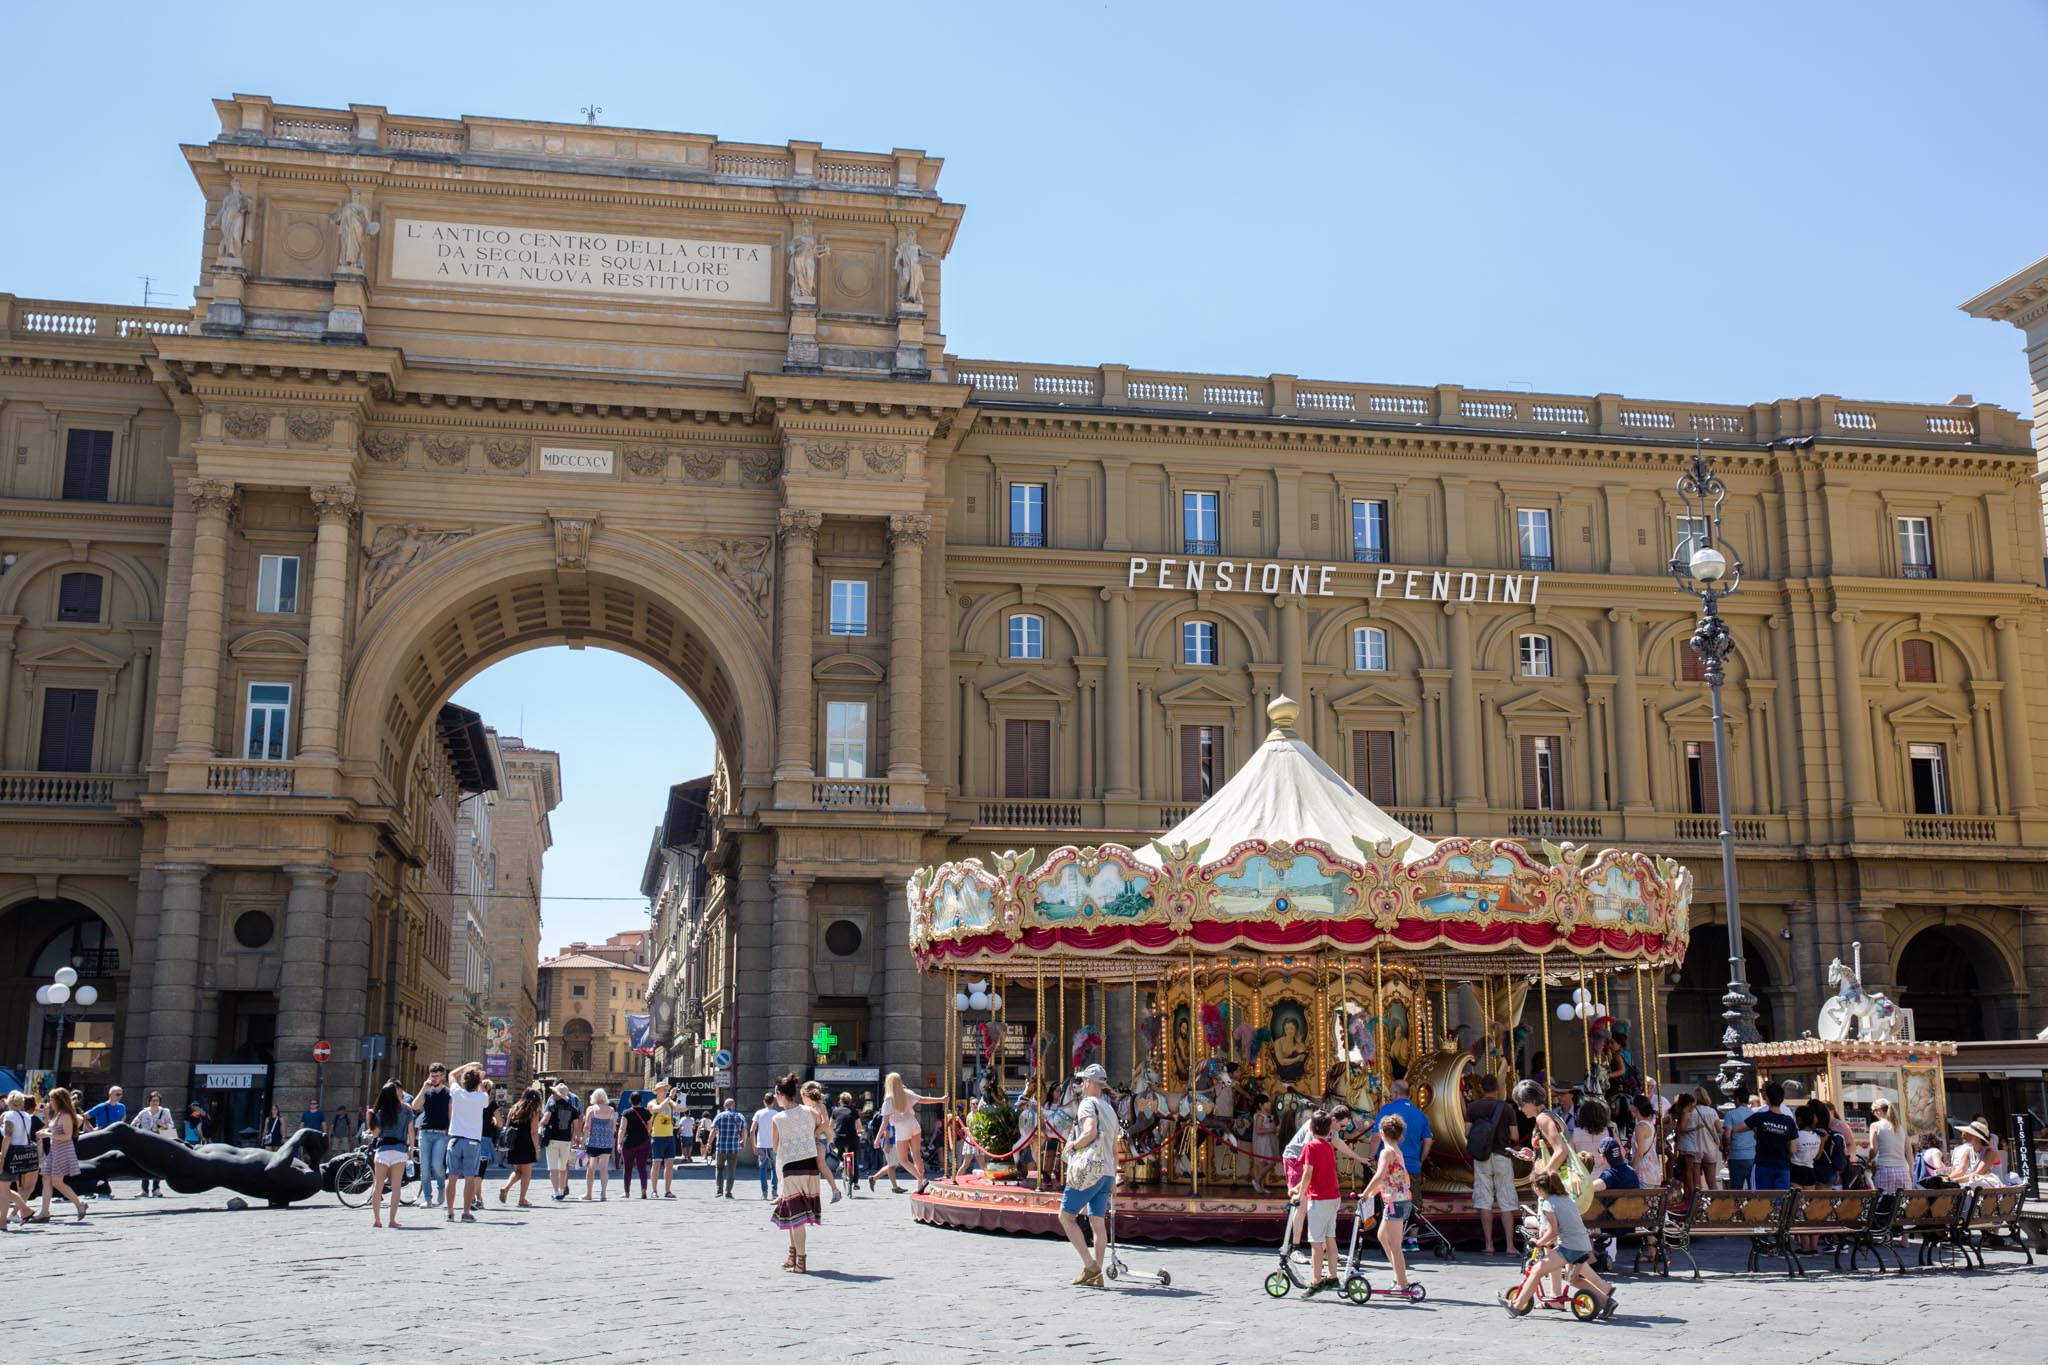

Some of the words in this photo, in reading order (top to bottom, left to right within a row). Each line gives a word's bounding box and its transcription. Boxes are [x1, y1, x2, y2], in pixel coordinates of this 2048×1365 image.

[432, 227, 510, 244] ANTICO
[520, 233, 607, 251] CENTRO
[616, 239, 687, 257] DELLA
[438, 244, 465, 258] DA
[476, 247, 591, 267] SECOLARE
[601, 255, 729, 276] SQUALLORE
[437, 262, 449, 275] A
[461, 263, 509, 279] VITA
[520, 267, 592, 284] NUOVA
[603, 272, 729, 293] RESTITUITO
[543, 454, 608, 467] MDCCCXCV
[1128, 557, 1337, 596] PENSIONE
[1376, 568, 1539, 605] PENDINI
[208, 1076, 251, 1087] VOGUE
